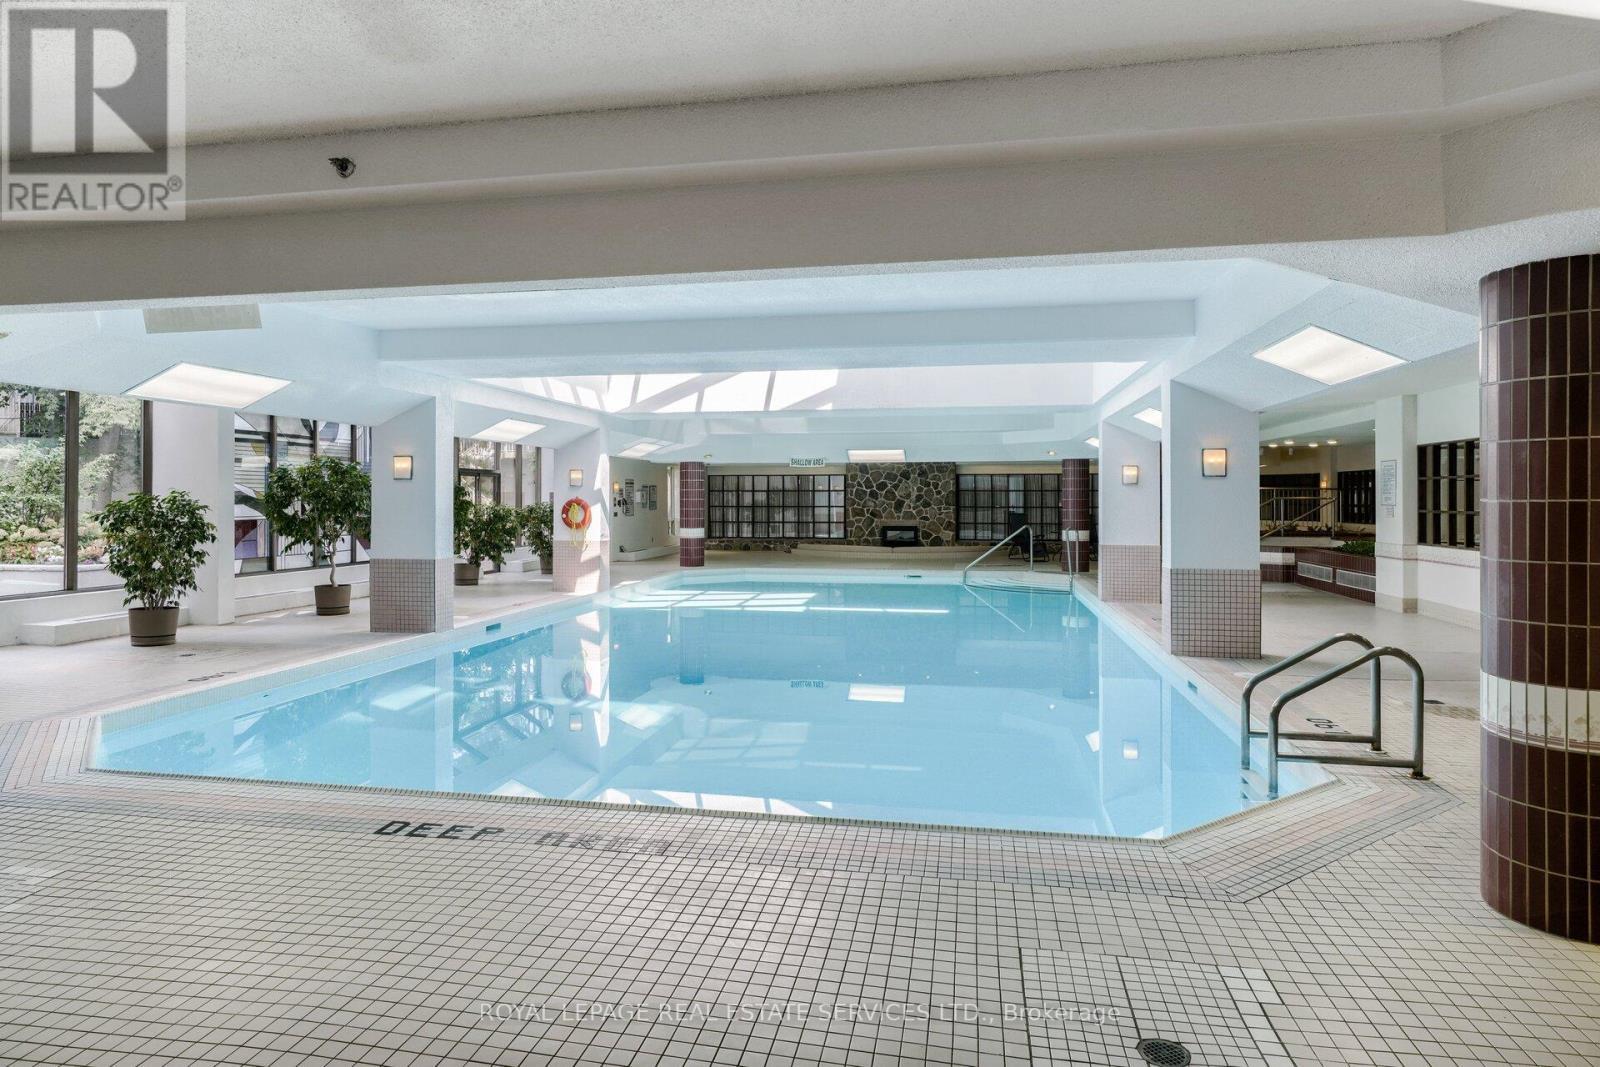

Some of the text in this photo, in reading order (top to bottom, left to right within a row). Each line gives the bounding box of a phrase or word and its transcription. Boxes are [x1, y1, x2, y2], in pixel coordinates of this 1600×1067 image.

[791, 458, 824, 466] SHALLOW AREA
[373, 820, 504, 841] DEEP
